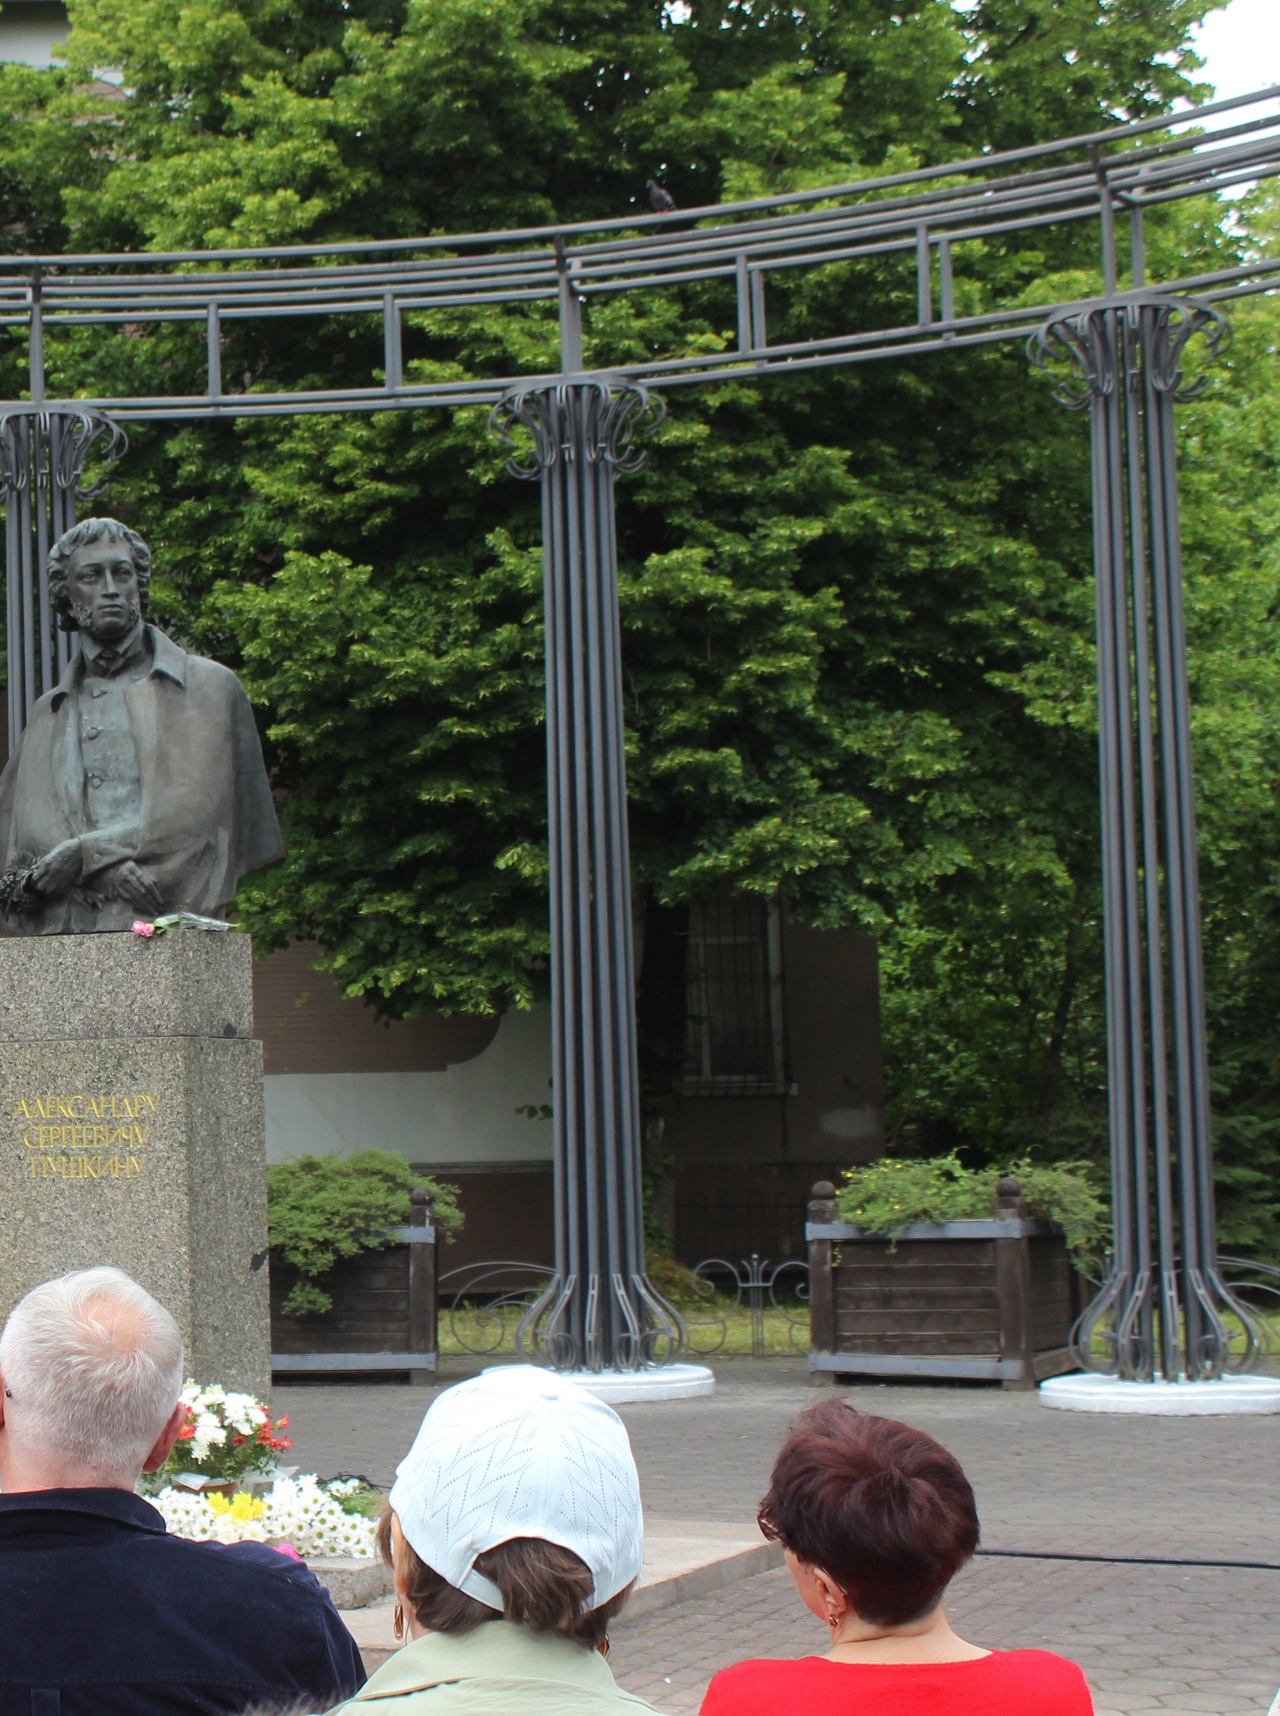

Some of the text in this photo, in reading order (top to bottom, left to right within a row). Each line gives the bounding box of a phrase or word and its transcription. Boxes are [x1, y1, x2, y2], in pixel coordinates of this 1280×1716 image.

[13, 1094, 161, 1118] АЛЕКСАНДРУ
[23, 1124, 149, 1148] СЕРГЕЕВИЧУ
[31, 1154, 145, 1178] ПУШКИНУ
